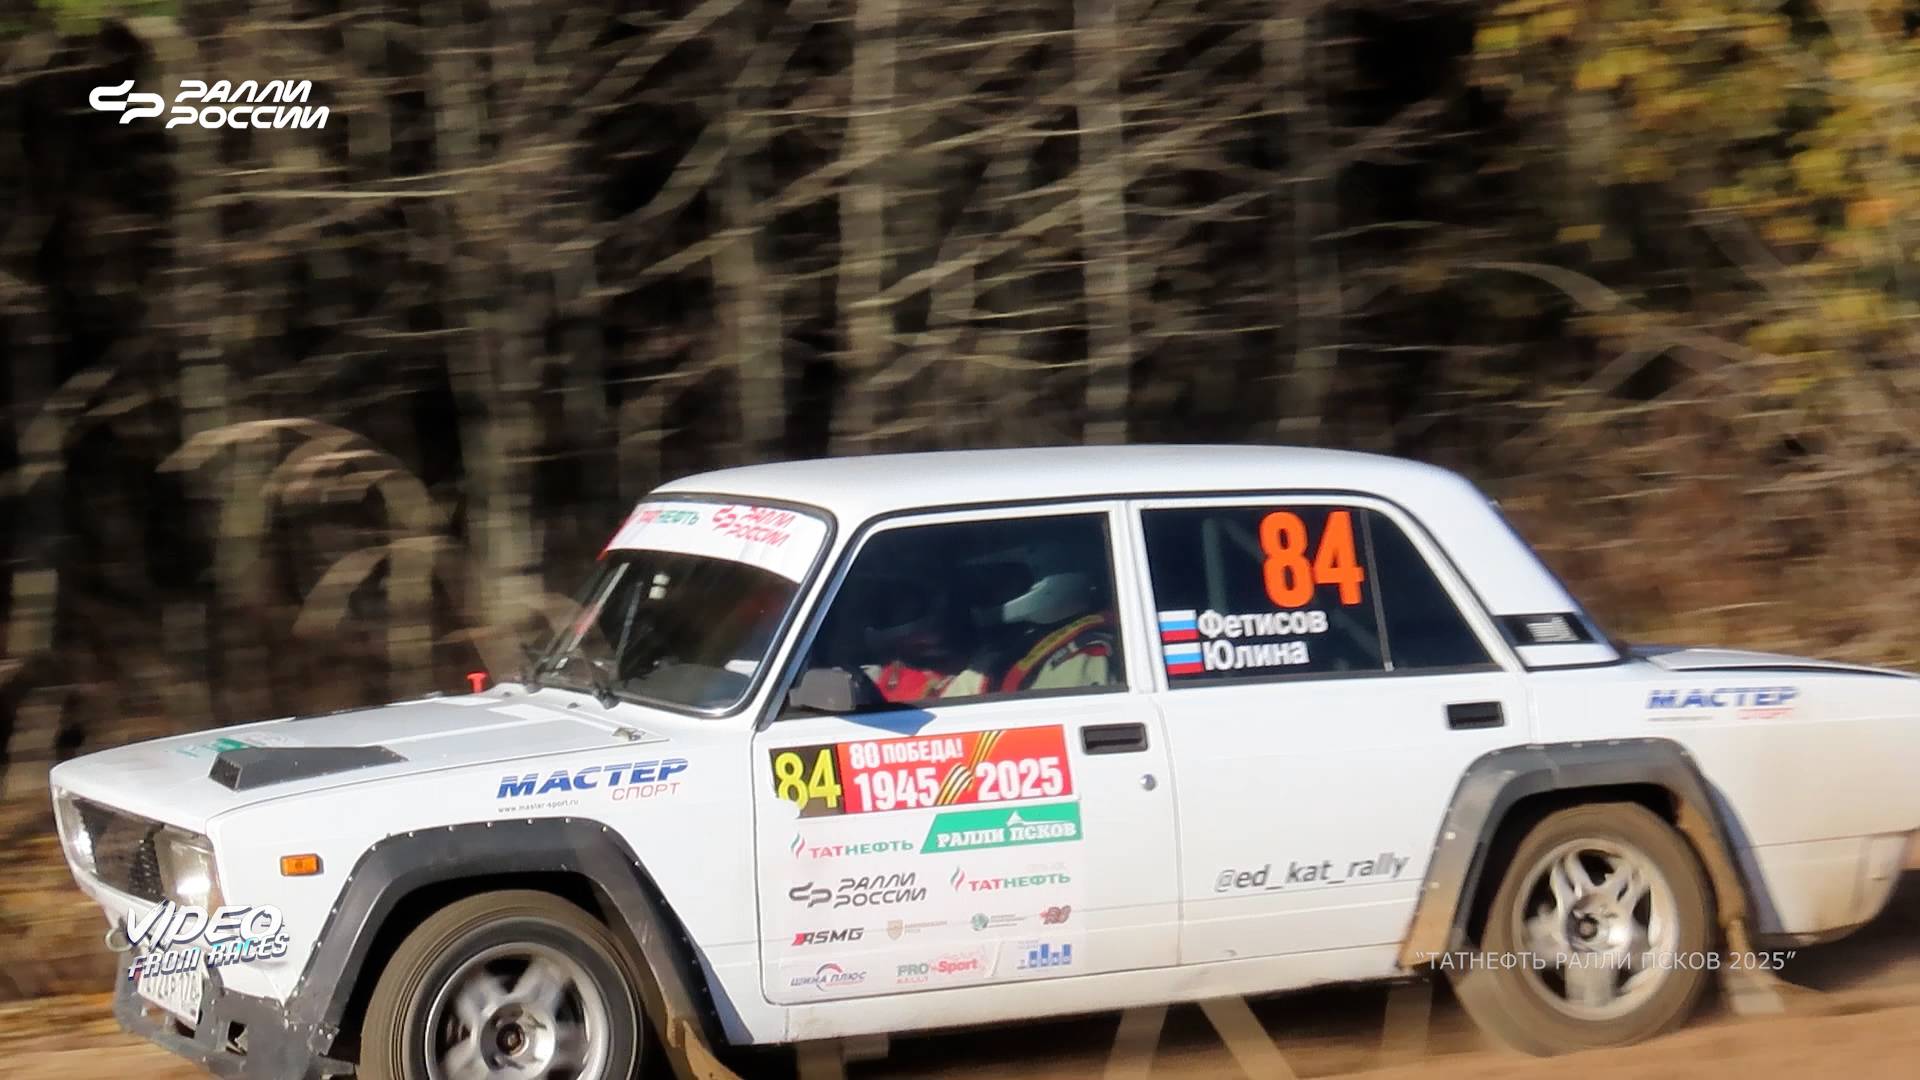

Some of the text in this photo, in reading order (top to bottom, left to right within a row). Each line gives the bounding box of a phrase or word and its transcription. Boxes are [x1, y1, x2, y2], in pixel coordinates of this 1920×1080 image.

[1259, 510, 1364, 608] 84
[1198, 609, 1329, 639] Фетисов
[1202, 639, 1310, 671] Юлина
[1645, 686, 1799, 709] МАСТЕР
[850, 738, 963, 769] 80 ПОБЕДА!
[497, 758, 688, 798] МАСТЕР
[612, 782, 681, 801] СПОРТ
[775, 748, 842, 811] 84
[854, 756, 1064, 812] 1945 2025
[937, 822, 1077, 848] РАЛЛИ ПСКОВ
[809, 839, 914, 860] ТАТНЕФТЬ
[838, 872, 916, 892] РАЛЛИ
[968, 873, 1071, 892] ТАТНЕФТЬ
[1214, 852, 1410, 893] @ed_kat_rally
[833, 887, 927, 909] РОССИИ
[830, 971, 867, 982] ПЛЮС
